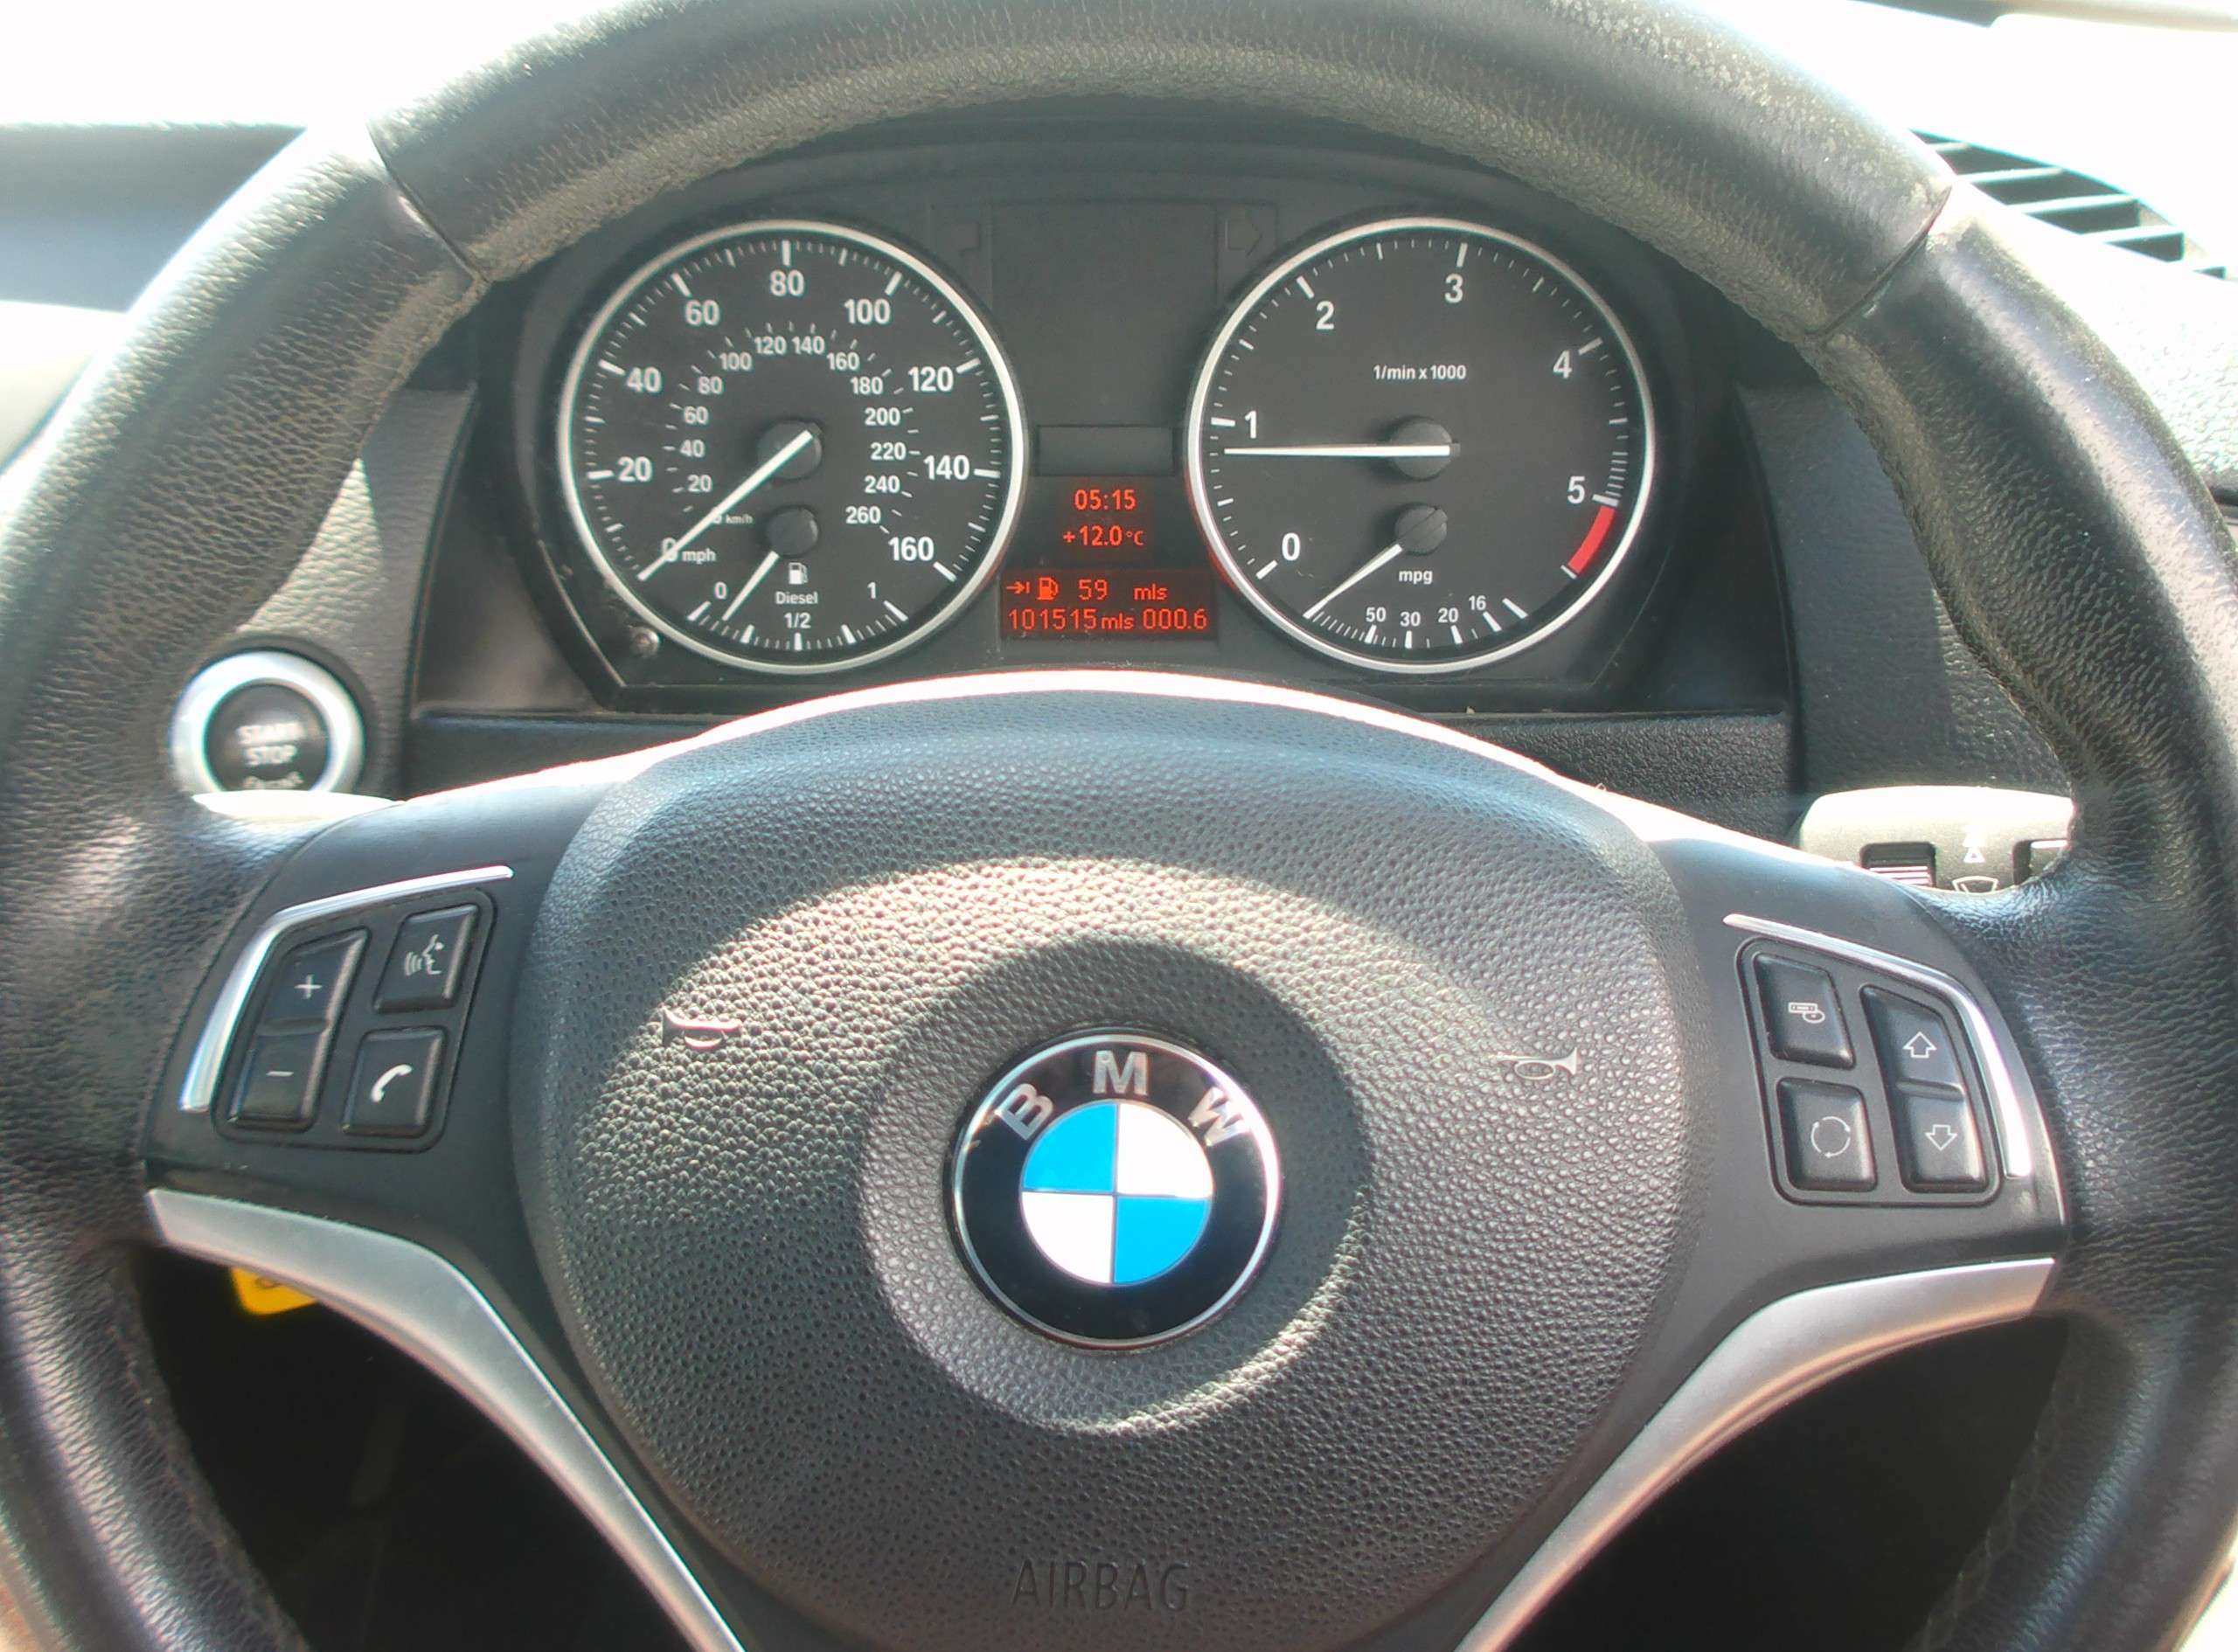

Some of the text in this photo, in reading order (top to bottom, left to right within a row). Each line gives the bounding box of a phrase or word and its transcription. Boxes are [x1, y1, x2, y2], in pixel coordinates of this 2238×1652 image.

[769, 269, 804, 297] 80
[1444, 274, 1463, 303] 3
[685, 299, 719, 326] 60
[844, 298, 891, 324] 100
[1316, 301, 1335, 330] 2
[754, 335, 787, 355] 120
[791, 335, 825, 355] 140
[719, 351, 753, 371] 100
[826, 351, 860, 371] 160
[1553, 351, 1573, 378] 4
[626, 366, 661, 392] 40
[907, 365, 954, 392] 120
[1373, 364, 1467, 380] 1/min x 1000
[698, 376, 723, 395] 80
[850, 376, 884, 395] 180
[684, 406, 709, 425] 60
[865, 406, 901, 427] 200
[1244, 410, 1257, 439] 1
[679, 439, 705, 458] 40
[870, 441, 907, 461] 220
[617, 456, 652, 482] 20
[923, 455, 970, 481] 140
[687, 474, 712, 493] 20
[864, 475, 900, 494] 240
[1567, 475, 1586, 504] 5
[1074, 489, 1136, 510] 05:15
[726, 514, 754, 524] km/h
[845, 505, 881, 524] 260
[682, 547, 717, 565] mph
[887, 536, 935, 561] 160
[1282, 532, 1301, 561] 0
[1398, 570, 1433, 585] mpg
[714, 581, 727, 600] 0
[775, 591, 818, 605] Diesel
[867, 581, 877, 600] 1
[1078, 579, 1167, 601] 59 mls
[1468, 594, 1487, 611] 16
[784, 612, 811, 629] 1/2
[1143, 607, 1207, 630] 000.6
[1366, 607, 1387, 623] 50
[1400, 611, 1421, 628] 30
[1438, 607, 1459, 623] 20
[995, 1050, 1253, 1147] BMW
[1011, 1558, 1190, 1612] AIRBAG
